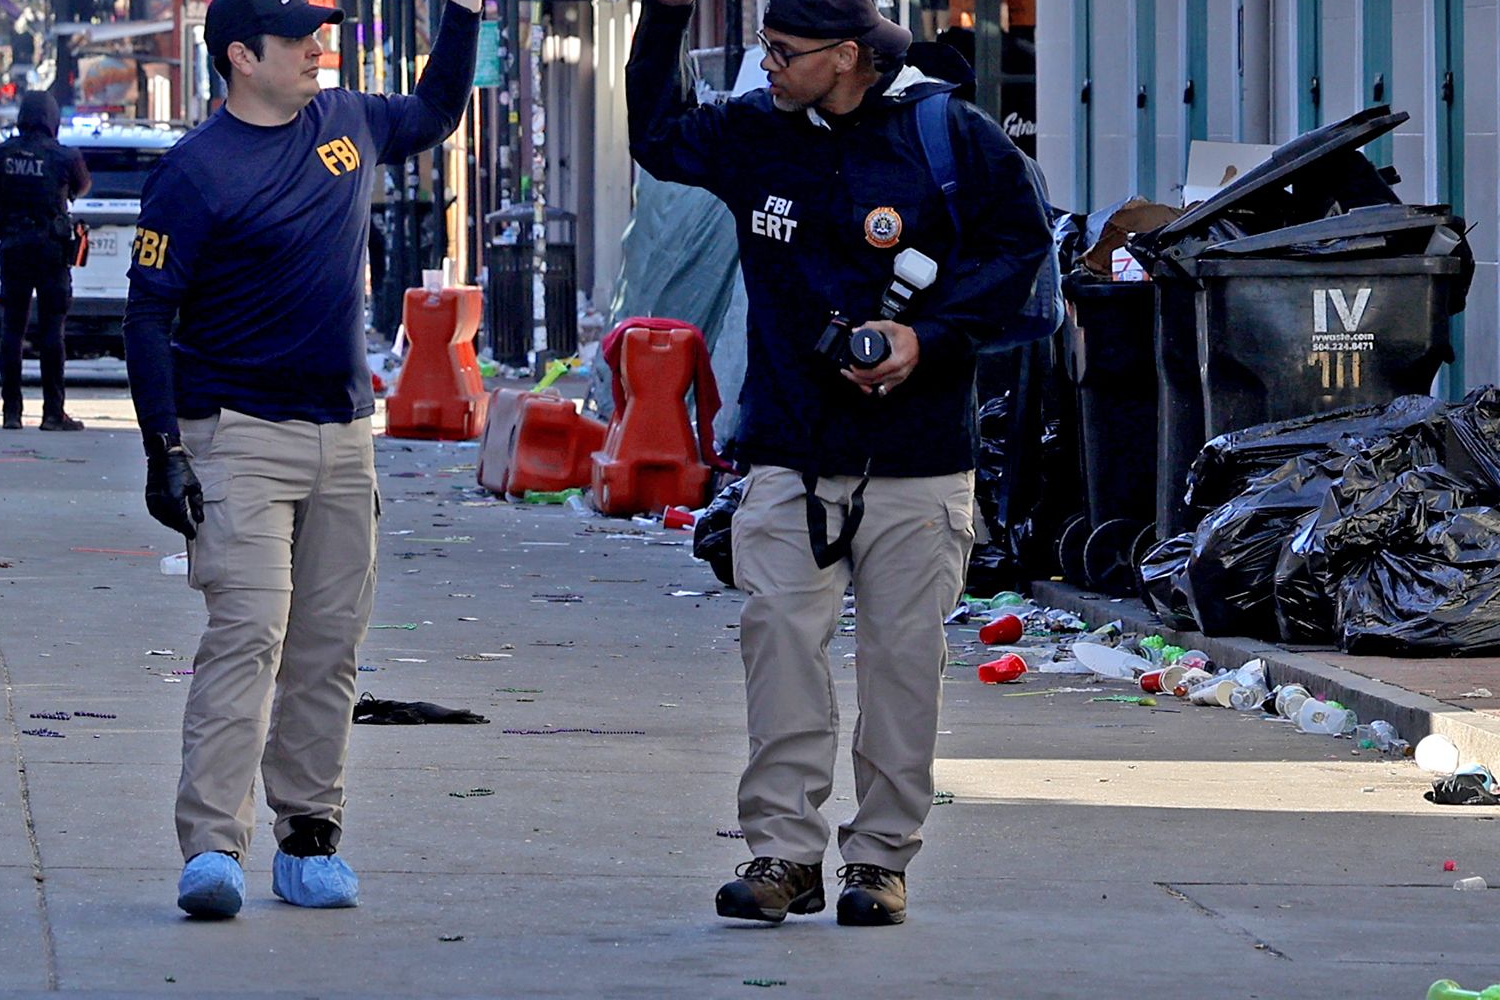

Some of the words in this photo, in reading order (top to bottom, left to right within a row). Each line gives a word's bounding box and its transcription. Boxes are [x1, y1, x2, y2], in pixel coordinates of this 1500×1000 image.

[316, 135, 361, 177] FBI
[764, 194, 793, 217] FBI
[751, 209, 798, 243] ERT
[1313, 288, 1372, 333] IV
[1312, 342, 1375, 352] 504.224.8471
